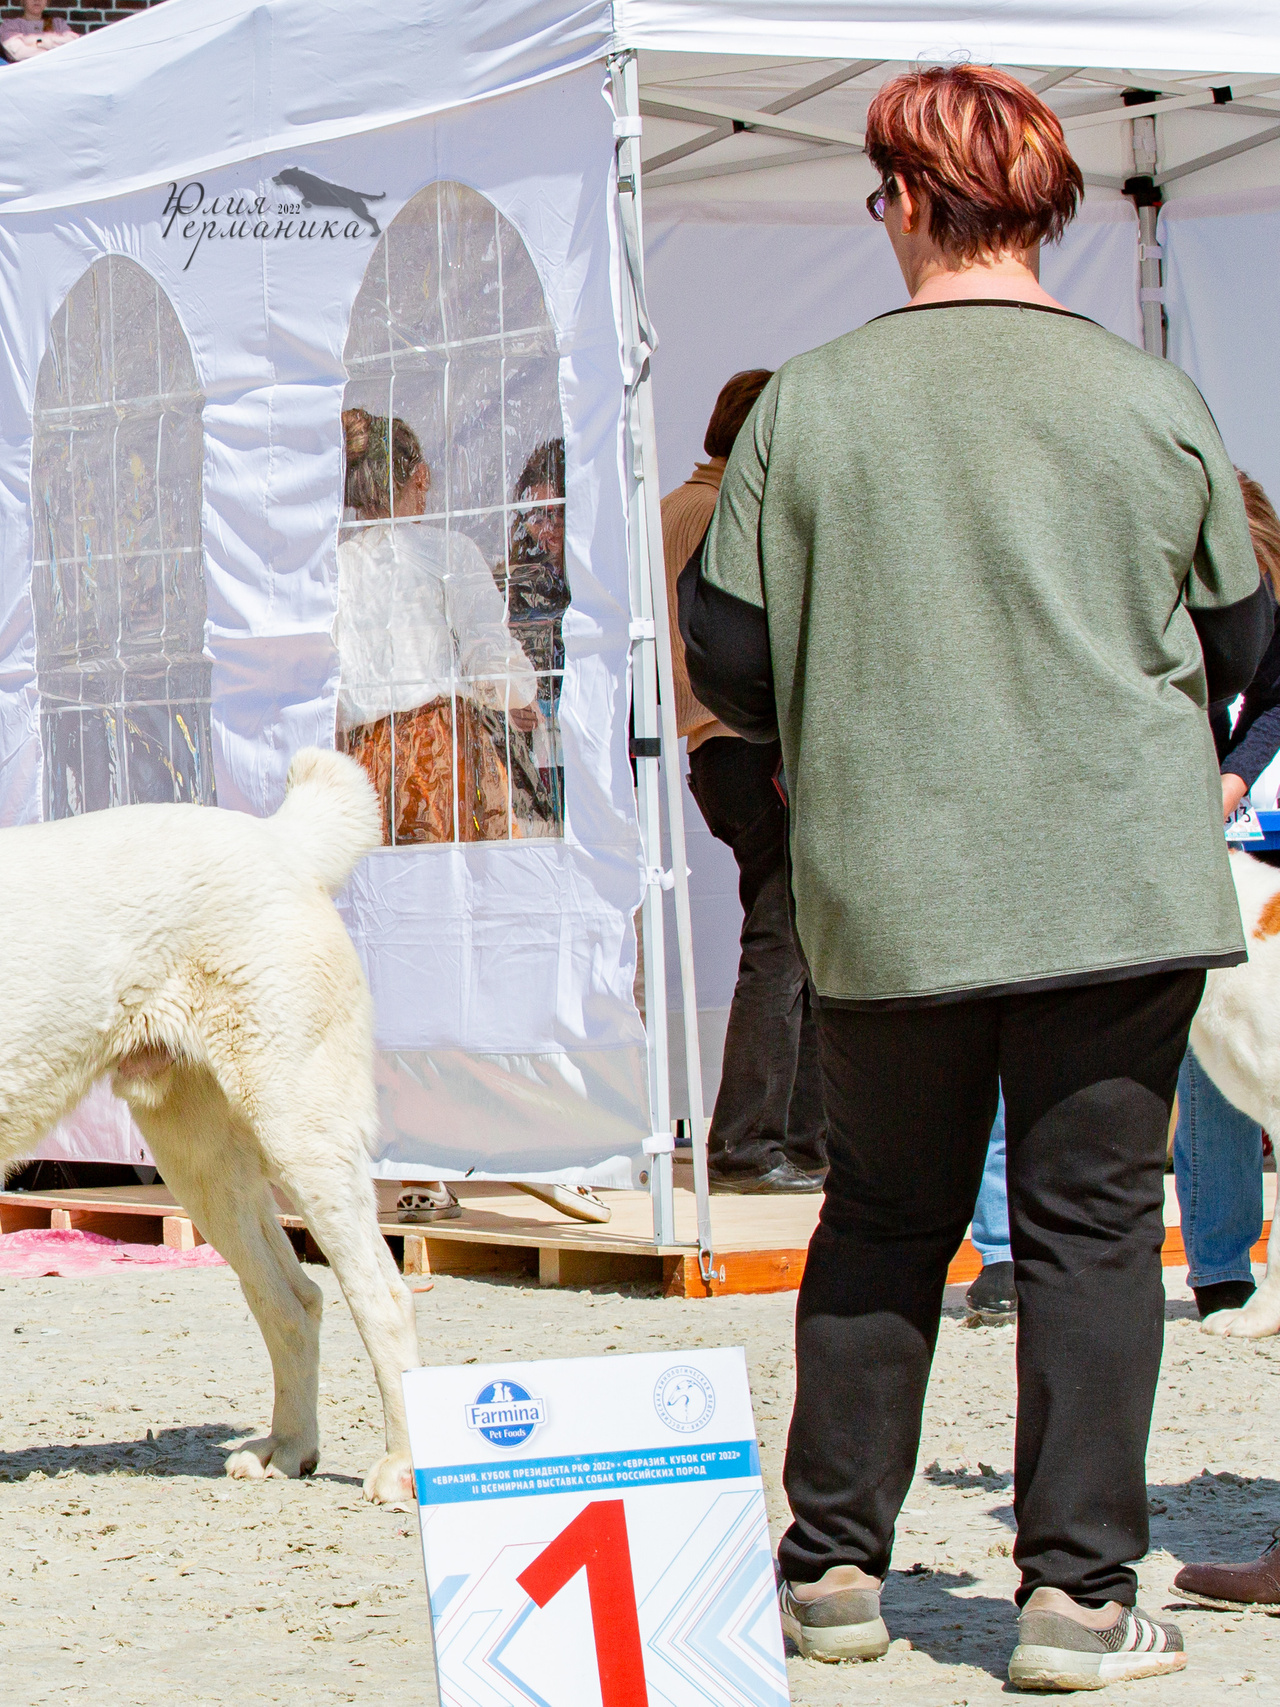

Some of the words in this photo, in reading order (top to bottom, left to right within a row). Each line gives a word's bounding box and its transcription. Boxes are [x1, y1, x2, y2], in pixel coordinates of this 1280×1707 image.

[470, 1404, 540, 1425] Farmina
[489, 1429, 502, 1439] Pet
[504, 1427, 527, 1438] Foods
[432, 1473, 479, 1485] «ЕВРАЗИЯ.
[481, 1470, 511, 1482] КУБОК
[513, 1465, 570, 1478] ПРЕЗИДЕНТА
[572, 1461, 591, 1473] РКФ
[593, 1461, 615, 1472] 2022»
[623, 1457, 668, 1468] «ЕВРАЗИЯ.
[670, 1453, 699, 1465] КУБОК
[701, 1451, 717, 1462] СНГ
[719, 1450, 741, 1460] 2022»
[481, 1480, 535, 1493] ВСЕМИРНАЯ
[536, 1477, 584, 1488] ВЫСТАВКА
[586, 1472, 614, 1483] СОБАК
[616, 1466, 675, 1481] РОССИЙСКИХ
[676, 1465, 707, 1477] ПОРОД
[516, 1499, 649, 1707] 1
